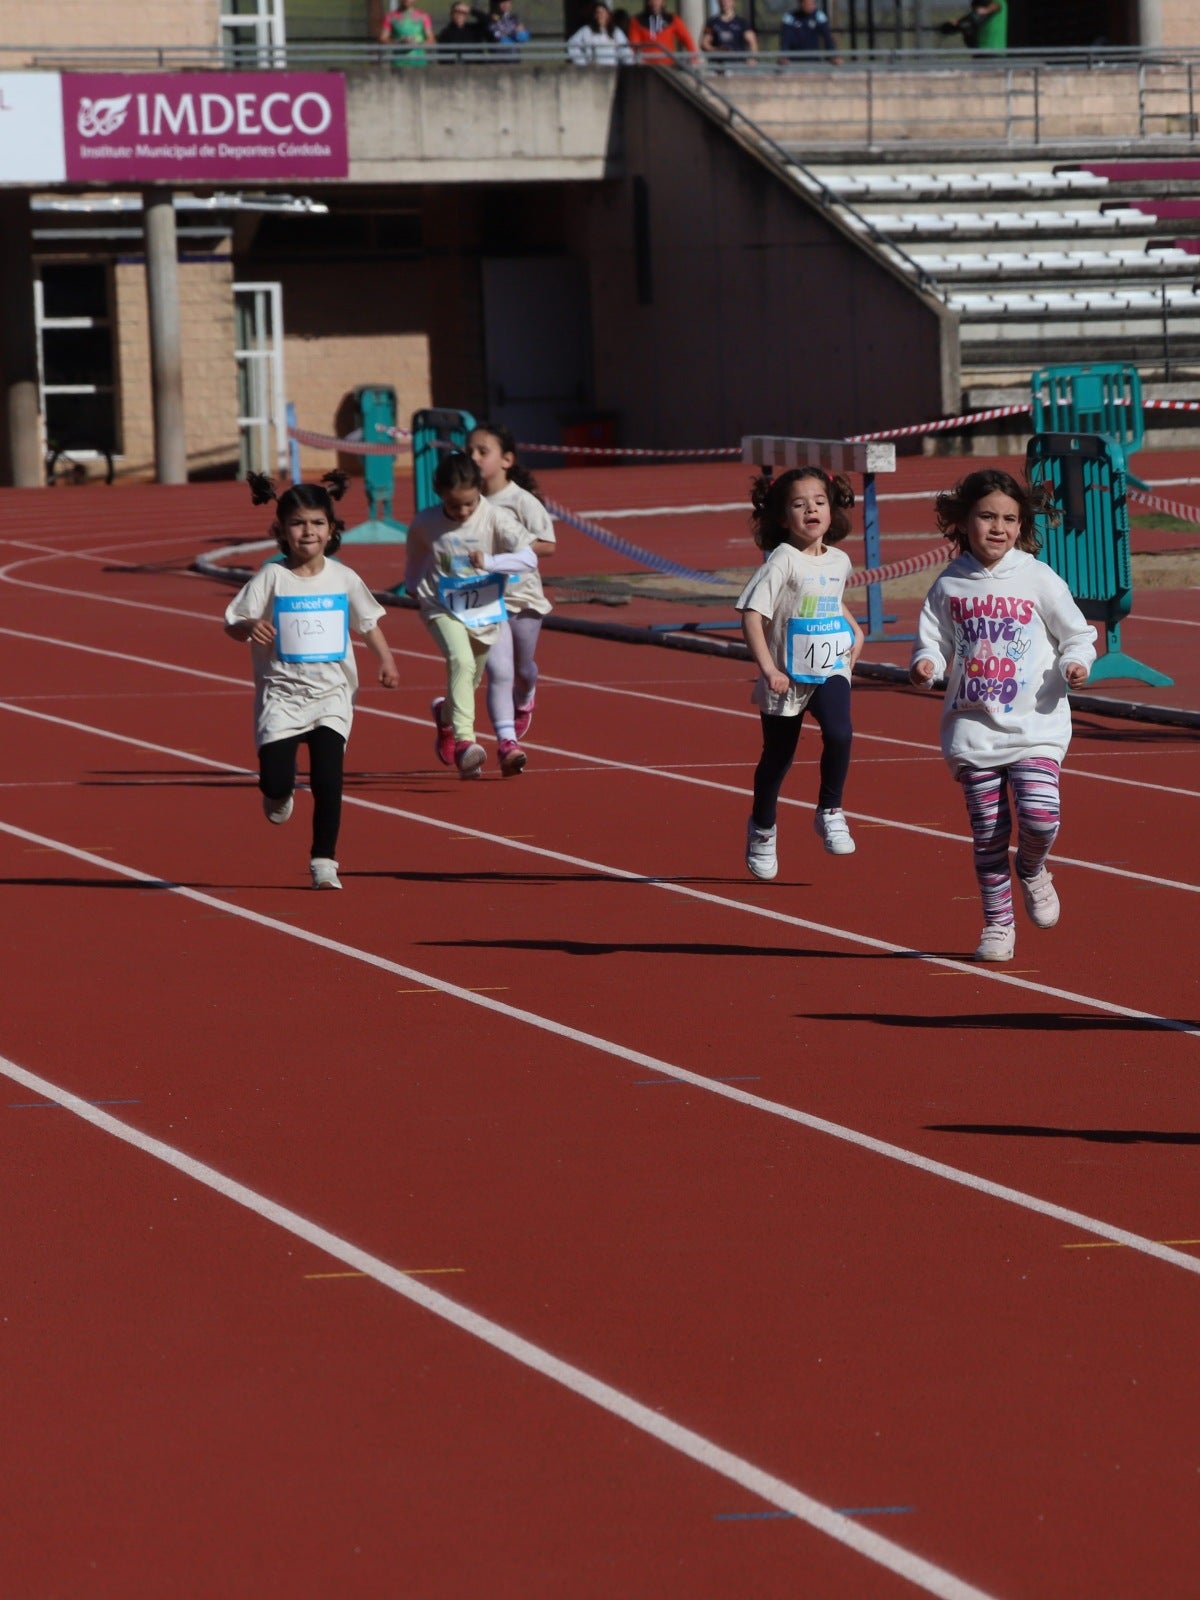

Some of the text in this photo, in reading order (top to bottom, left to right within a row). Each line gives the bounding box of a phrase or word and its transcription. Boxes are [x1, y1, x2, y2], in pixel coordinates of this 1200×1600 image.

[137, 91, 332, 136] IMDECO
[135, 143, 197, 160] Municipal
[199, 143, 216, 158] de
[218, 142, 276, 160] Deportes
[277, 141, 331, 158] Córdoba
[291, 597, 322, 611] unicef
[949, 594, 1034, 625] ALWAYS
[290, 618, 326, 639] 123
[806, 619, 834, 633] unicef
[960, 617, 1016, 644] HAVE
[975, 639, 994, 660] A
[964, 656, 1016, 683] OOD
